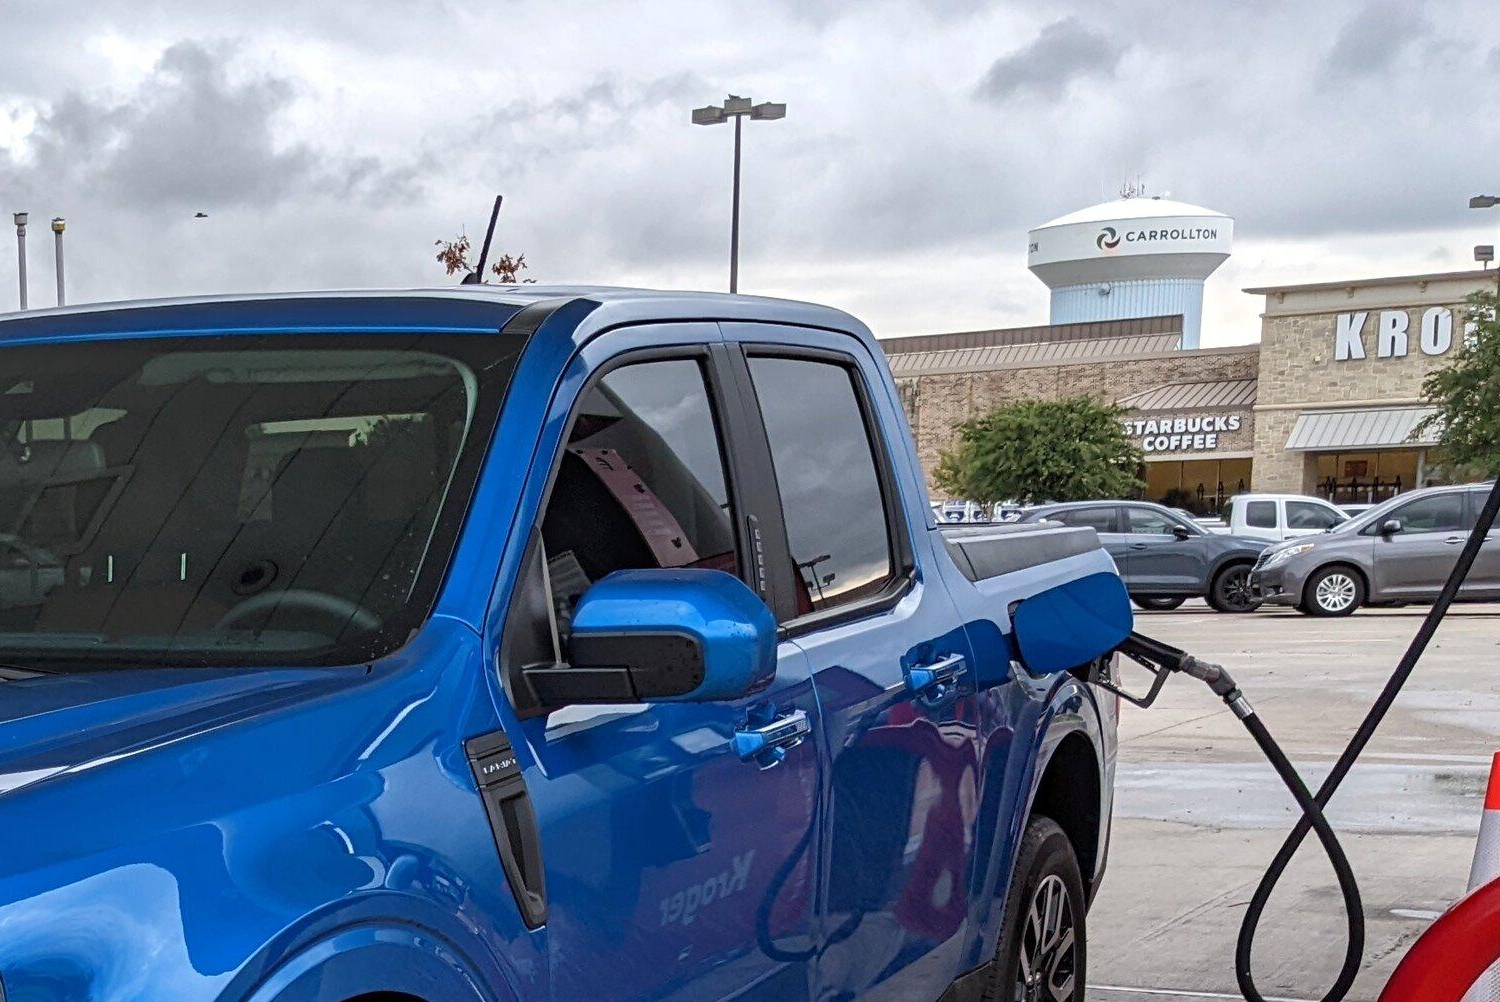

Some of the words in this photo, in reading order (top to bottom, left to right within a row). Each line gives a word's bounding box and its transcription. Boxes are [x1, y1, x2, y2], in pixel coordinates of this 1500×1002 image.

[1125, 228, 1218, 242] CARROLLTON
[1122, 416, 1240, 435] STARBUCKS
[1143, 434, 1217, 452] COFFEE
